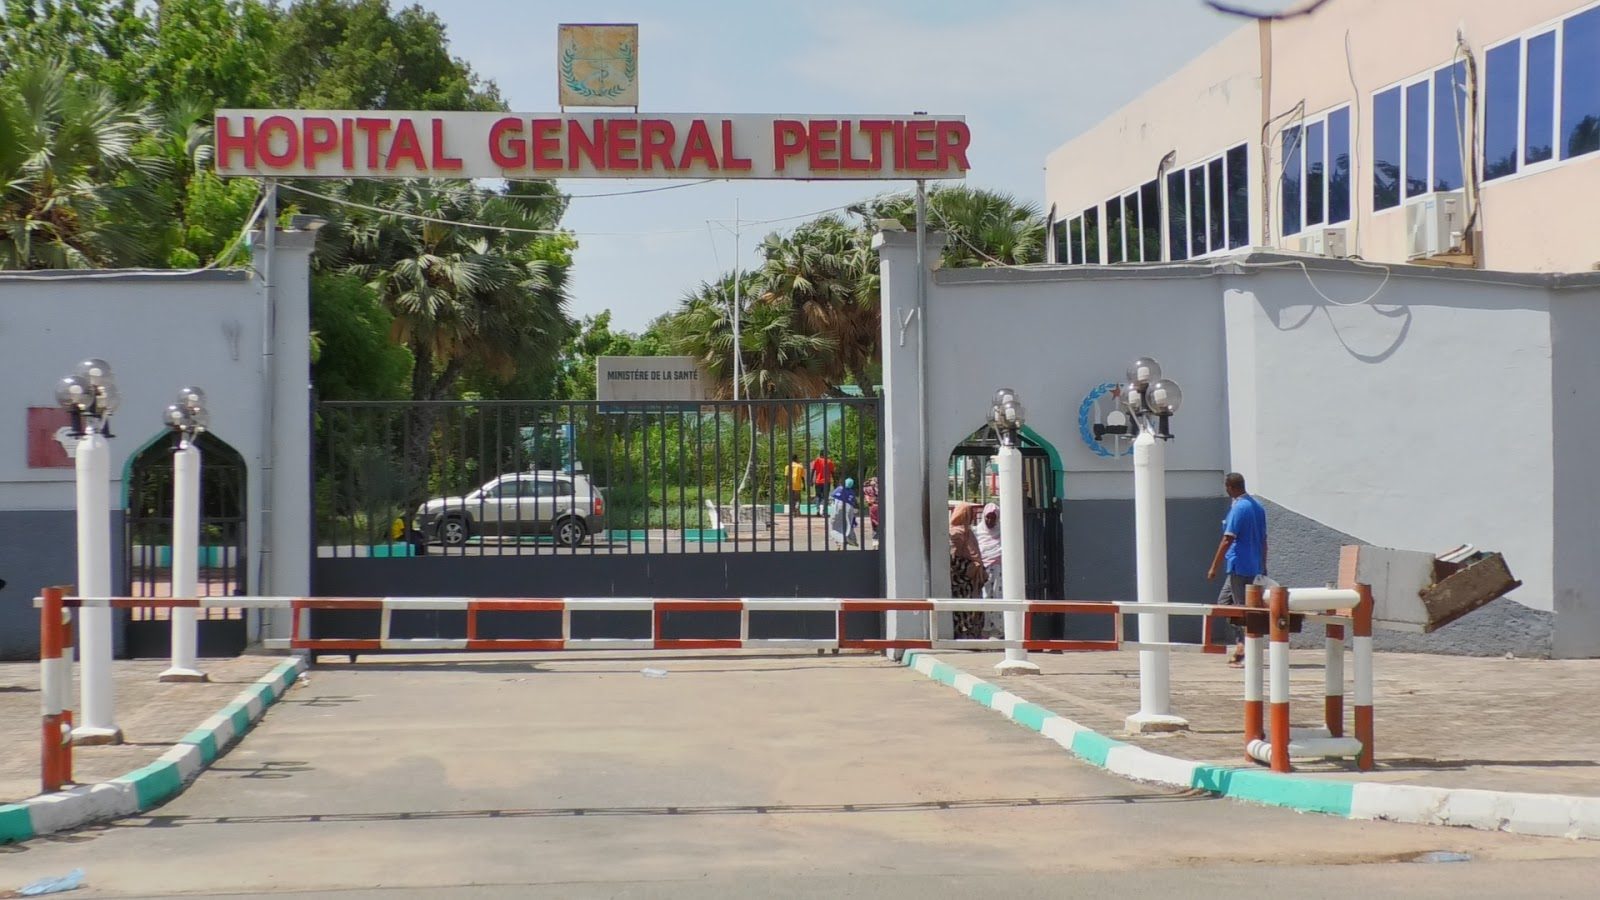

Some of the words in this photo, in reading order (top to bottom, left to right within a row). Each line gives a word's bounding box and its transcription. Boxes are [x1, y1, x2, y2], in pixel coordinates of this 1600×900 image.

[215, 115, 463, 170] HOPITAL
[488, 117, 752, 171] GENERAL
[773, 119, 971, 172] PELTIER
[651, 370, 661, 380] DE
[662, 370, 672, 380] LA
[673, 369, 698, 380] SANTÉ
